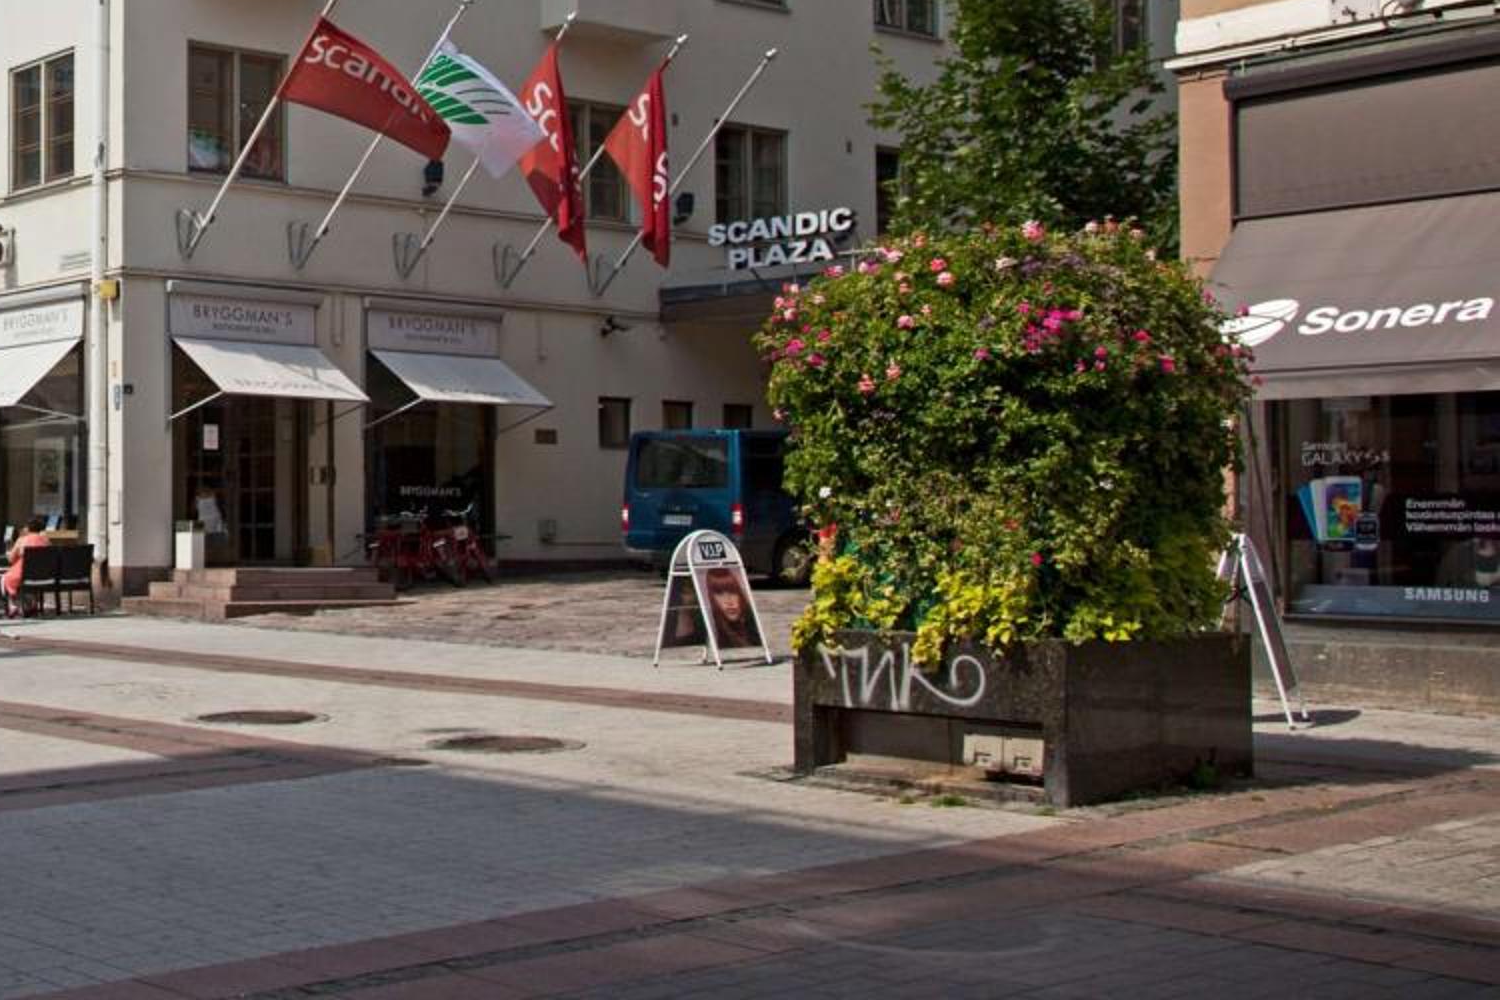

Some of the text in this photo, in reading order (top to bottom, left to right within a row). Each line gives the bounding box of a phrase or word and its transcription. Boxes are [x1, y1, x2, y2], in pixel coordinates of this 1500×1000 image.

[707, 206, 853, 247] SCANDIC
[729, 237, 834, 272] PLAZA
[192, 303, 293, 327] BRYGGMAN'S
[1297, 297, 1495, 336] Sonera
[1404, 587, 1490, 603] SAMSUNG
